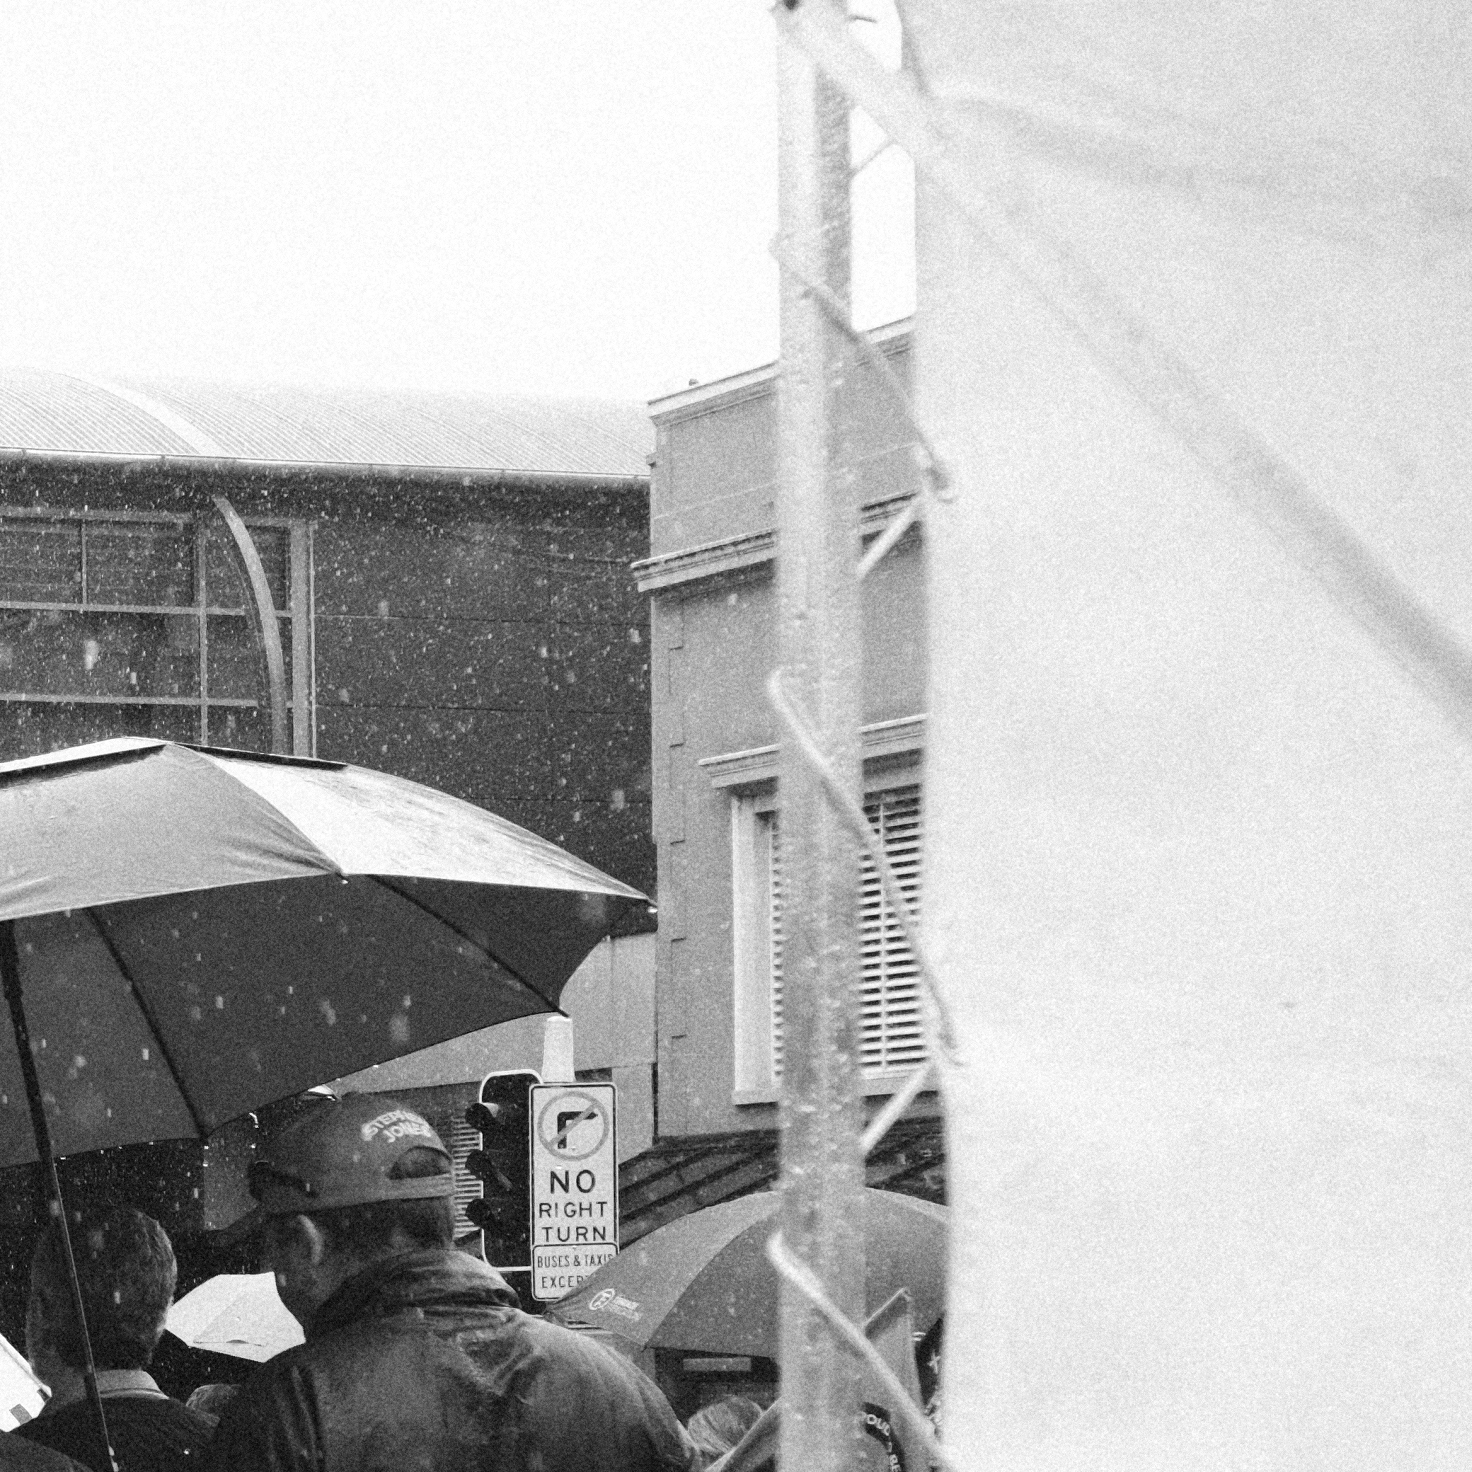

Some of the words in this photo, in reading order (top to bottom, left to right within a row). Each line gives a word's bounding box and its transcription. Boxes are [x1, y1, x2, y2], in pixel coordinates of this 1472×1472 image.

[549, 1169, 596, 1194] NO
[538, 1201, 608, 1219] RIGHT
[541, 1226, 607, 1243] TURN
[537, 1255, 571, 1269] BUSES
[572, 1254, 582, 1268] &
[541, 1274, 590, 1290] EXCEP
